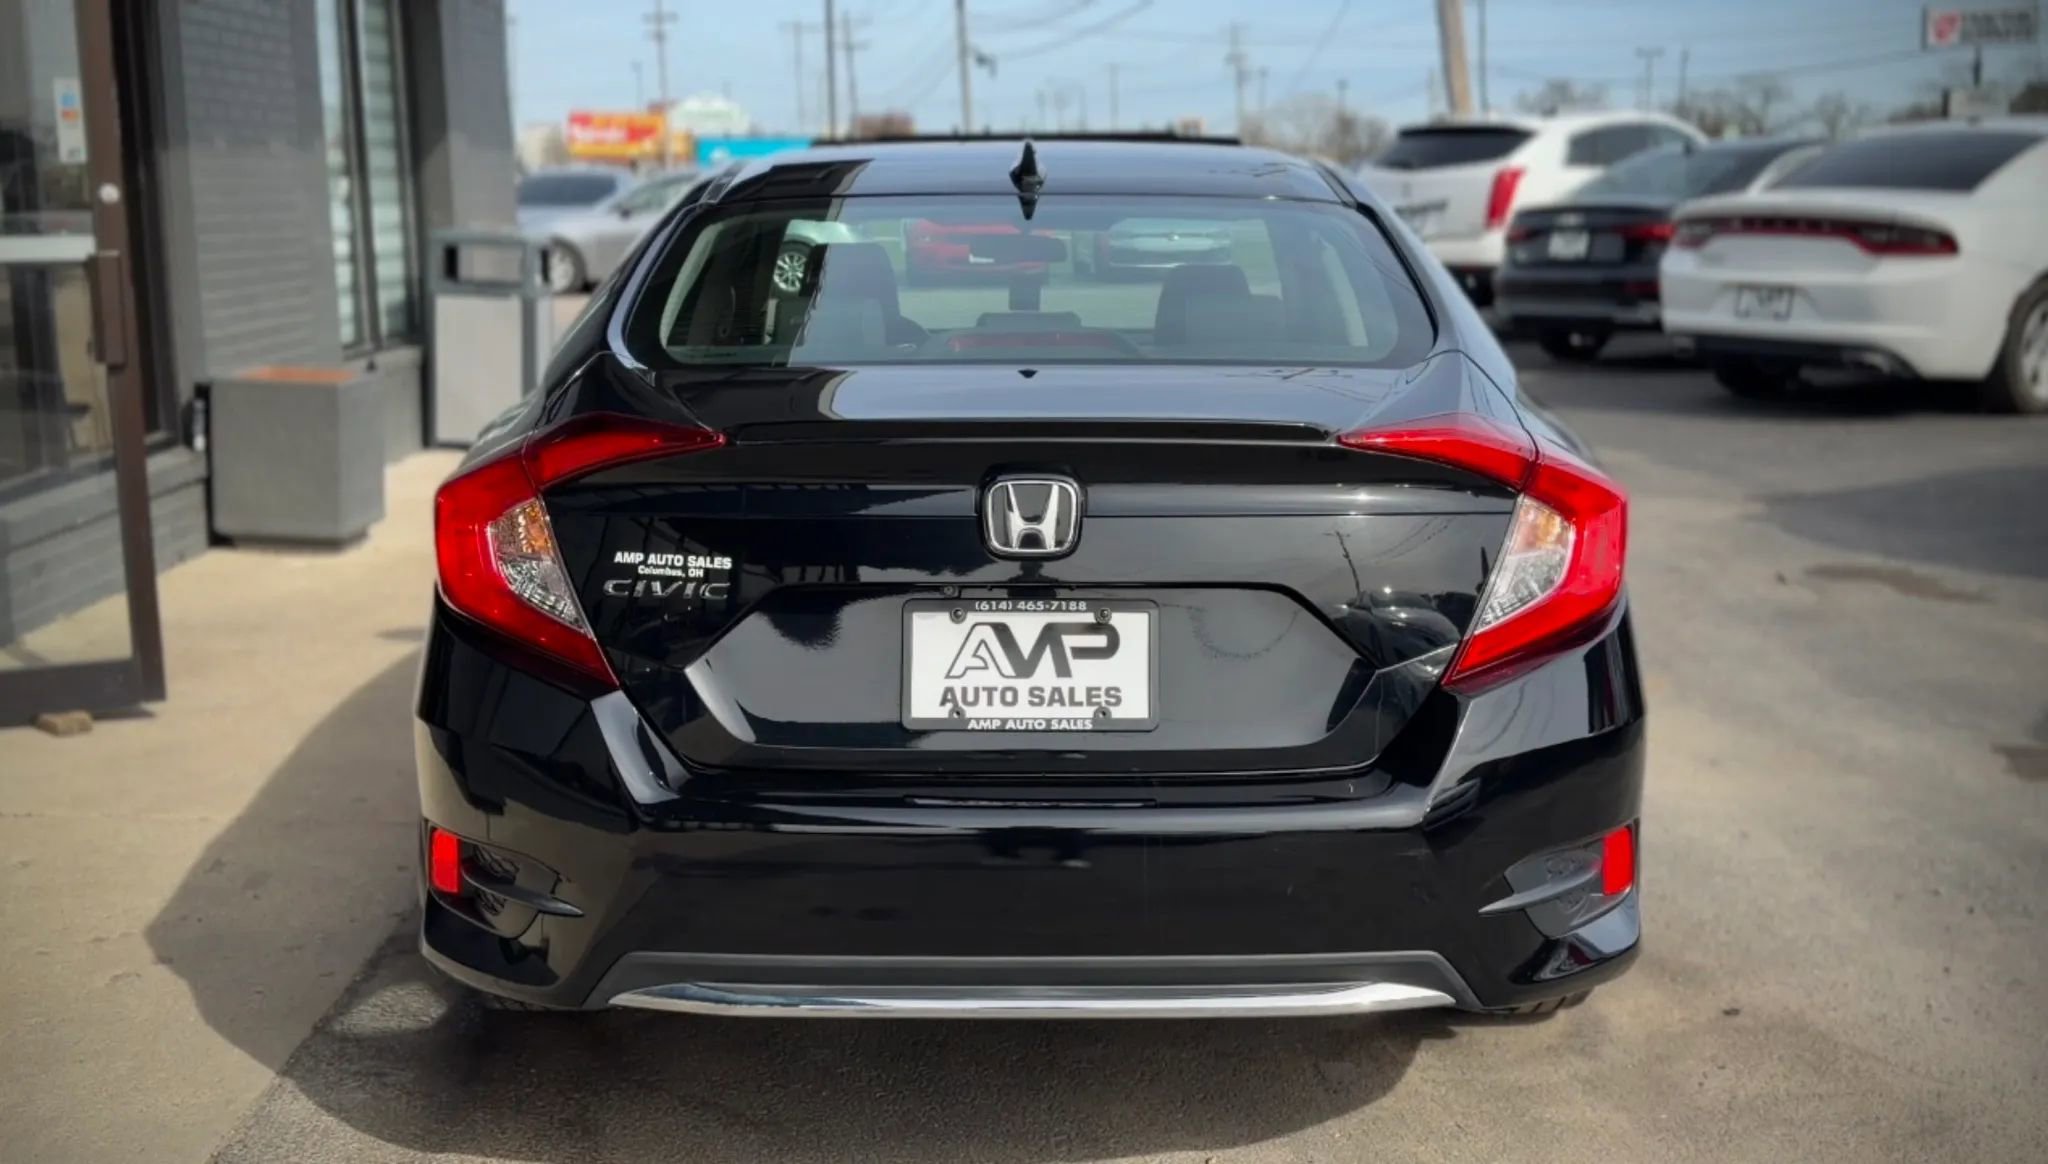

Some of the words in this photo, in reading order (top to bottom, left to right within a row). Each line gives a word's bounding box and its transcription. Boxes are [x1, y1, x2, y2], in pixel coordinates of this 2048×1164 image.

[614, 551, 644, 564] AMP
[647, 553, 684, 567] AUTO
[687, 556, 732, 569] SALES
[638, 565, 686, 577] Columbus,
[688, 568, 704, 578] OH
[603, 579, 731, 599] CIVIC
[975, 601, 1012, 610] (614)
[1016, 601, 1087, 610] 465-7188
[944, 622, 1120, 679] AMP
[939, 686, 1019, 707] AUTO
[1027, 686, 1122, 707] SALES
[967, 719, 1001, 730] AMP
[1005, 719, 1046, 730] AUTO
[1050, 719, 1093, 730] SALES
